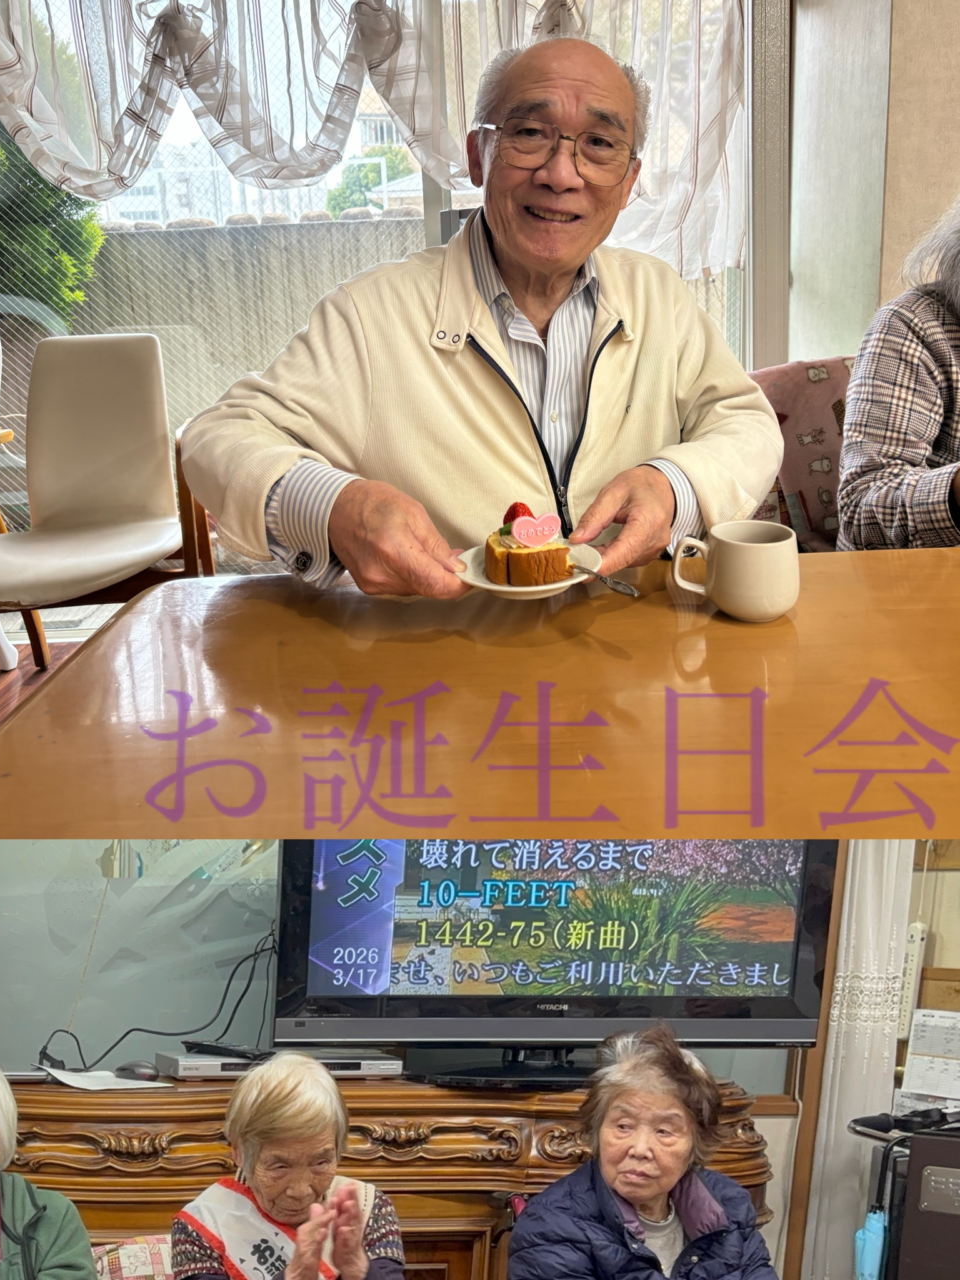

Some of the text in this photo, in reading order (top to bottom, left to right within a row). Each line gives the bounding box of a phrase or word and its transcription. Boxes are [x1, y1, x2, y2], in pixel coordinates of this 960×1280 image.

[519, 525, 556, 539] おめでとう
[419, 840, 652, 871] 壊れて消えるまで
[333, 947, 378, 964] 2026
[333, 968, 377, 987] 3/17
